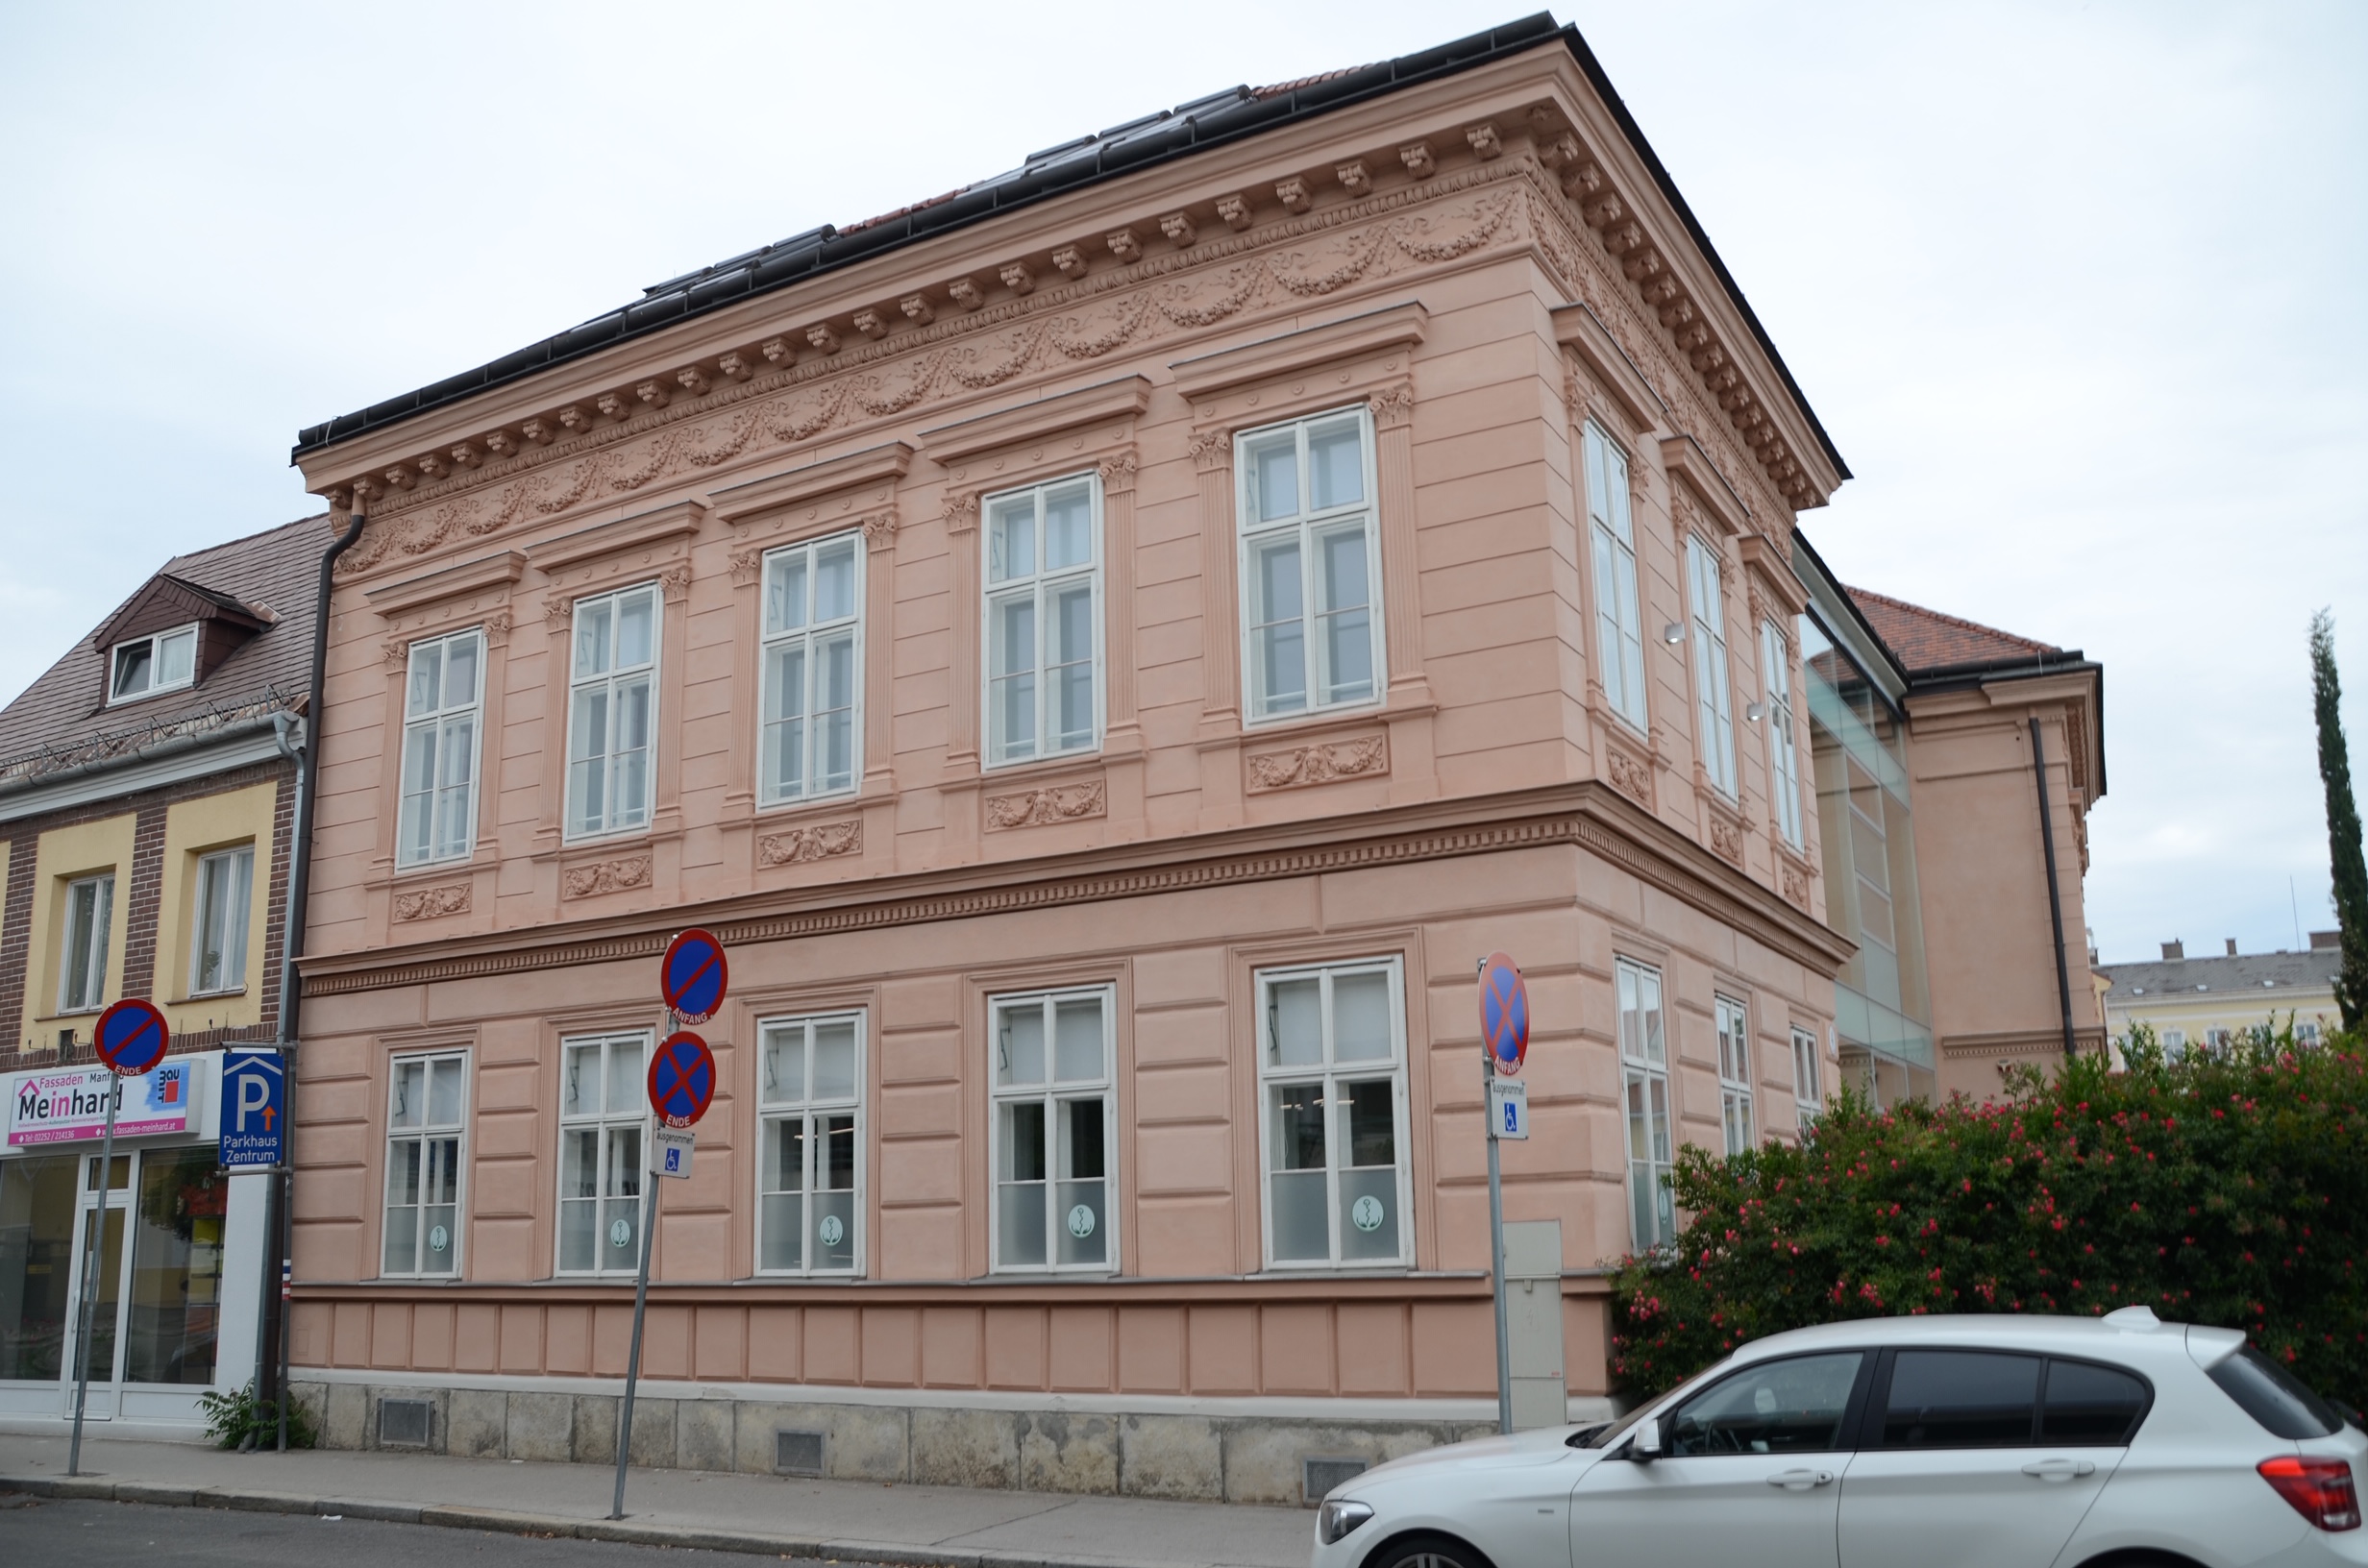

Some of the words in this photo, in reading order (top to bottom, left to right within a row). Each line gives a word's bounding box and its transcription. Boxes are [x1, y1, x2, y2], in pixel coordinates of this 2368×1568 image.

[673, 1007, 707, 1025] ANFANG
[115, 1065, 142, 1075] ENDE
[1494, 1054, 1520, 1074] ANFANG
[39, 1074, 84, 1089] Fassaden
[89, 1070, 124, 1084] Manf
[19, 1084, 123, 1120] Meinhard
[236, 1074, 270, 1132] P
[666, 1114, 691, 1128] ENDE
[223, 1135, 278, 1148] Parkhaus
[656, 1132, 694, 1144] ausgenommen
[226, 1149, 275, 1163] Zentrum
